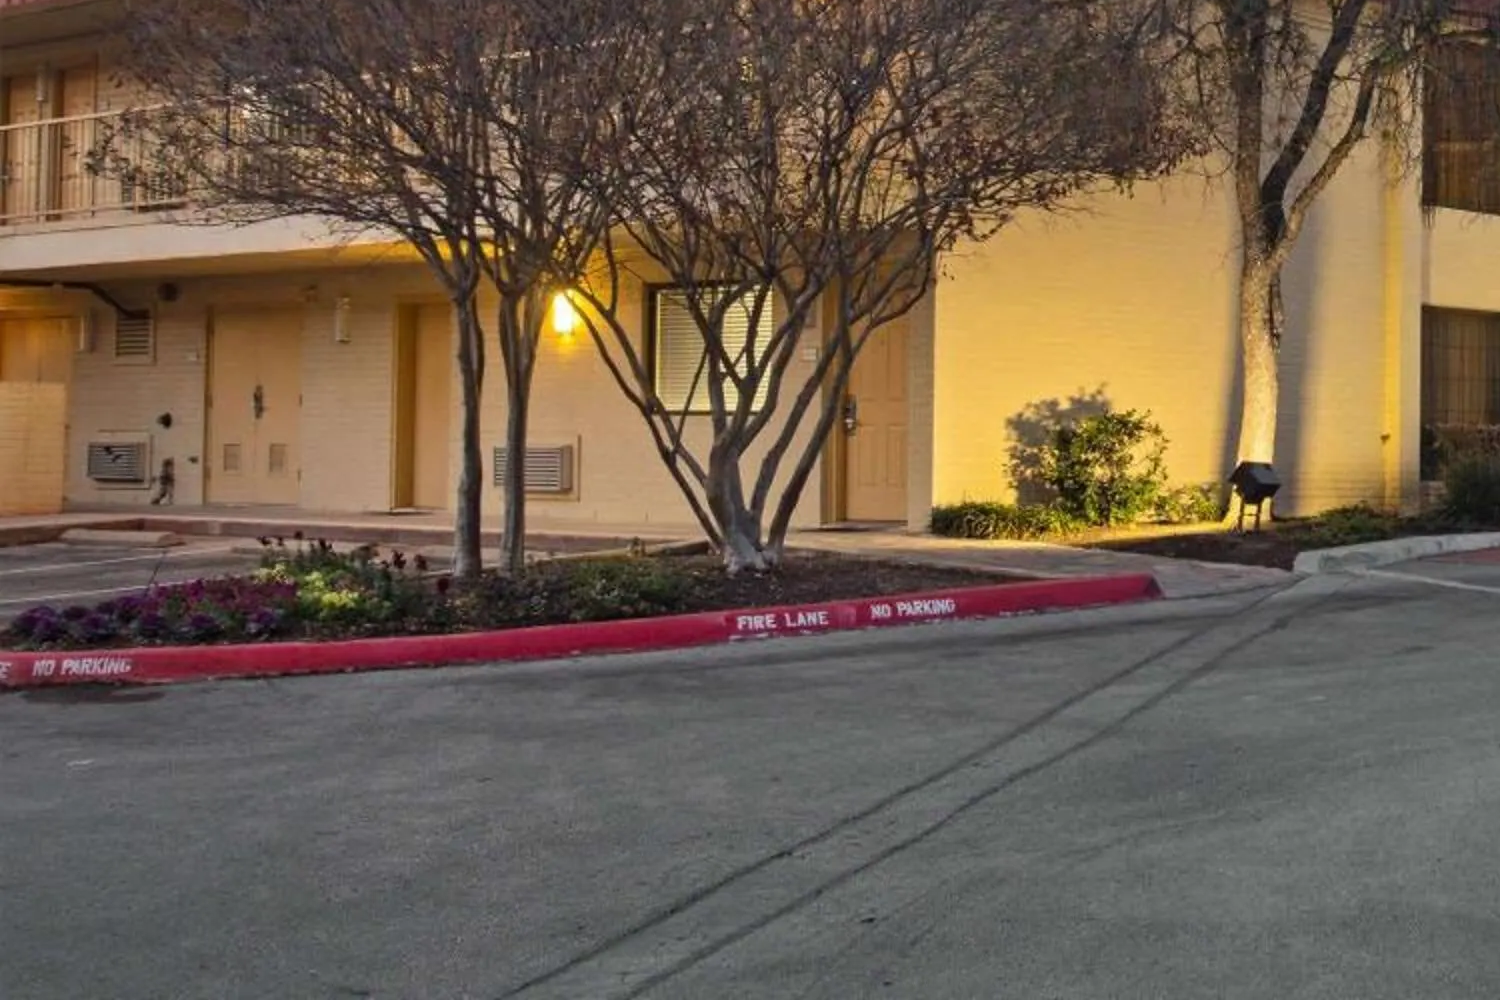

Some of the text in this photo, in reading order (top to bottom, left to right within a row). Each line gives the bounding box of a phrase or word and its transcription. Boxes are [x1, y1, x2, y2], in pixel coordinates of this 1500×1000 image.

[737, 598, 955, 630] FIRE LANE NO PARKING
[32, 659, 56, 677] NO
[61, 658, 132, 676] PARKING
